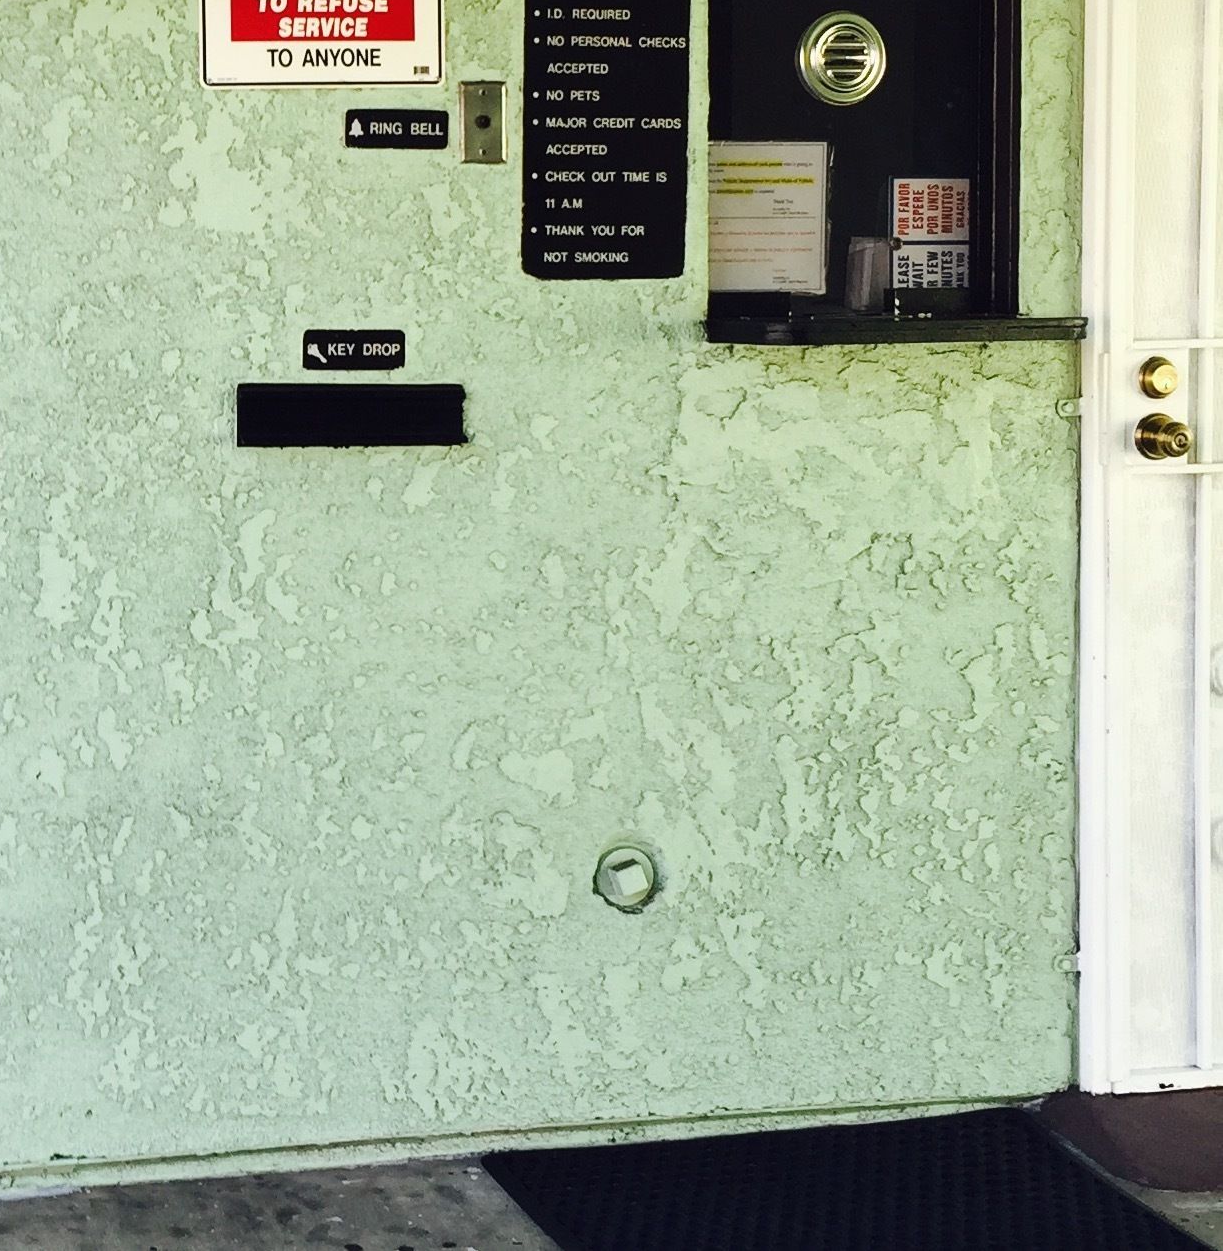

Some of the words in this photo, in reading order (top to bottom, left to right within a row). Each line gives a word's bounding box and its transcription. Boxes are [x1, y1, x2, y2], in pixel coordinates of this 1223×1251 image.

[573, 9, 630, 20] REQUIRED
[279, 17, 368, 37] SERVICE
[547, 36, 564, 46] NO
[571, 36, 632, 47] PERSONAL
[639, 37, 686, 48] CHECKS
[267, 48, 292, 67] TO
[303, 48, 381, 67] ANYONE
[547, 63, 608, 74] ACCEPTED
[547, 90, 563, 101] NO
[571, 90, 600, 101] PETS
[370, 122, 402, 135] RING
[411, 123, 443, 135] BELL
[546, 117, 586, 128] MAJOR
[593, 118, 635, 128] CREDIT
[641, 118, 681, 129] CARDS
[546, 144, 607, 155] ACCEPTED
[545, 171, 585, 182] CHECK
[592, 172, 616, 182] OUT
[622, 172, 649, 182] TIME
[656, 172, 667, 182] IS
[546, 198, 554, 208] 11
[898, 184, 910, 212] FAVOR
[927, 184, 939, 211] UNOS
[912, 190, 924, 229] ESPERE
[941, 186, 954, 233] MINUTOS
[956, 191, 966, 228] GRACIAS
[545, 225, 584, 235] THANK
[591, 225, 614, 236] YOU
[621, 225, 644, 236] FOR
[898, 217, 909, 235] POR
[927, 216, 939, 234] POR
[544, 252, 568, 262] NOT
[575, 252, 628, 262] SMOKING
[927, 251, 938, 274] FEW
[940, 251, 954, 288] NUTES
[328, 343, 355, 355] KEY
[363, 343, 400, 356] DROP
